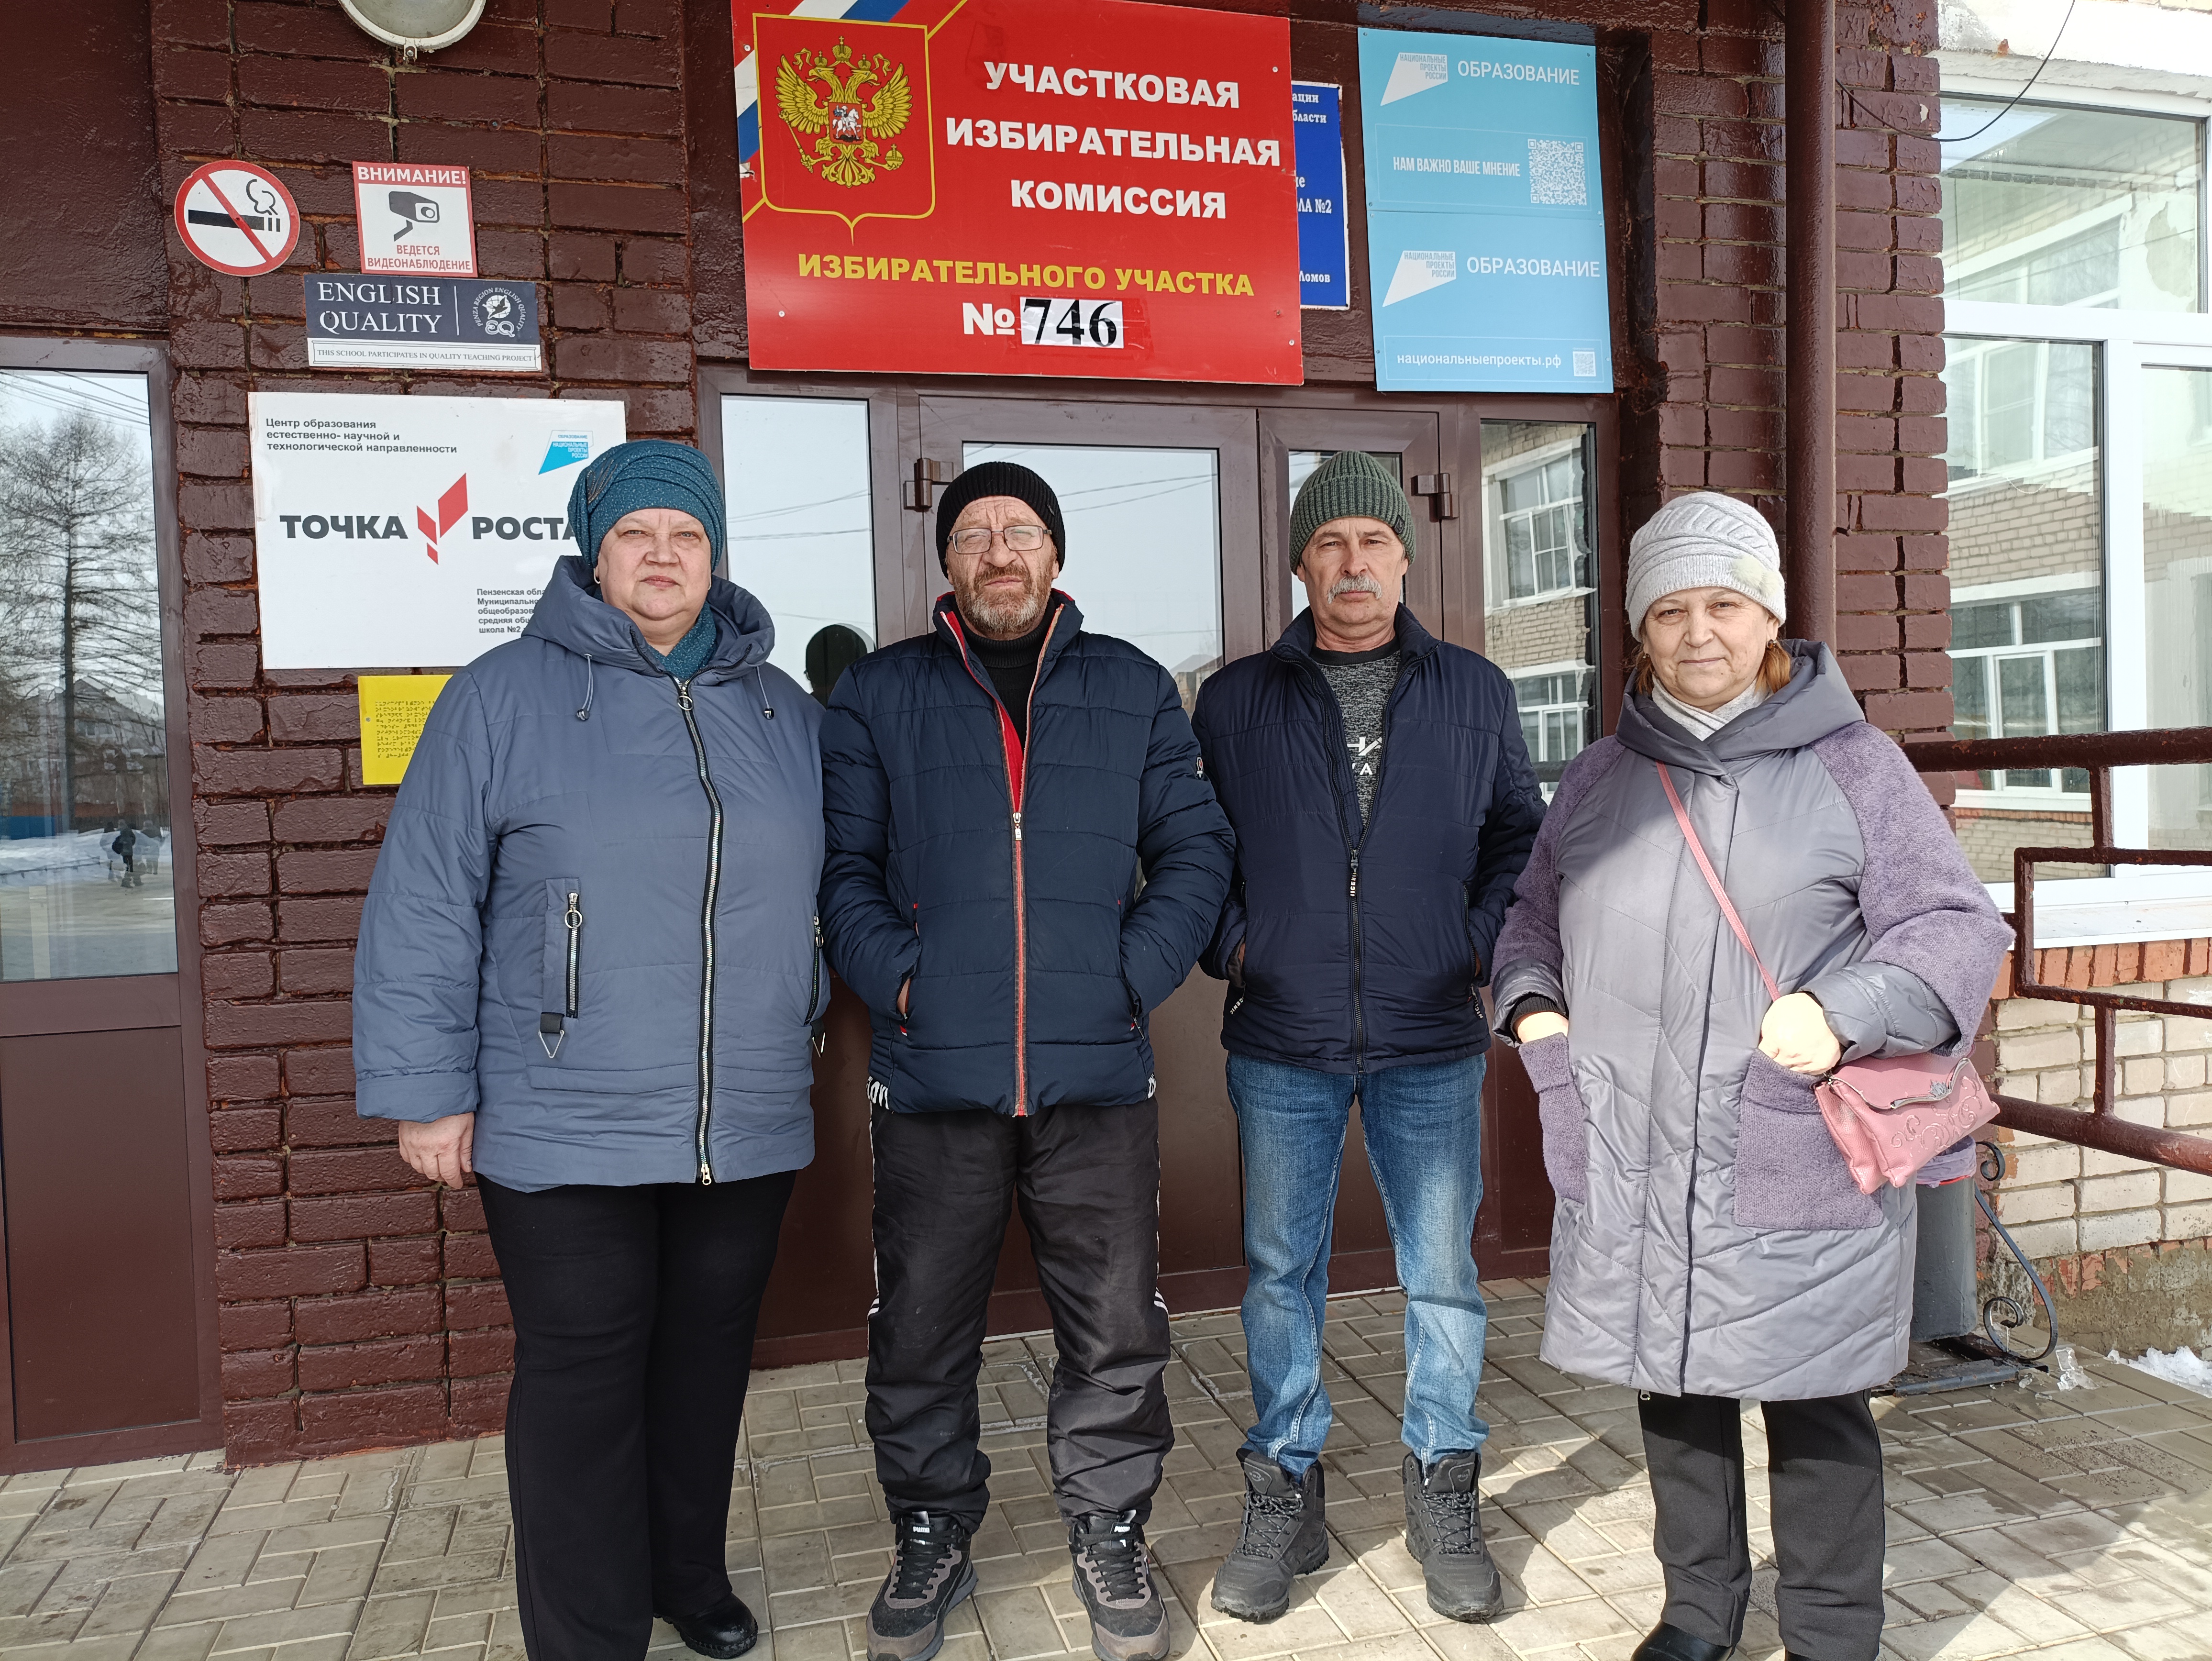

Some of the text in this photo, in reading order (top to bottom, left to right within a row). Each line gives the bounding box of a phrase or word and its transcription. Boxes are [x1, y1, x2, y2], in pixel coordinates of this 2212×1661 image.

[1400, 54, 1446, 64] НАЦИОНАЛЬНЫЕ
[1420, 63, 1446, 72] ПРОЕКТЫ
[1458, 60, 1580, 85] ОБРАЗОВАНИЕ
[1425, 71, 1447, 80] РОССИИ
[984, 60, 1239, 109] УЧАСТКОВАЯ
[1292, 93, 1319, 103] ации
[1292, 109, 1327, 123] бласти
[946, 117, 1280, 166] ИЗБИРАТЕЛЬНАЯ
[1393, 156, 1521, 177] НАМ ВАЖНО ВАШЕ МНЕНИЕ
[358, 166, 466, 184] ВНИМАНИЕ!
[1010, 179, 1227, 219] КОМИССИЯ
[1315, 199, 1332, 214] №2
[397, 245, 440, 256] ВЕДЕТСЯ
[1404, 252, 1454, 261] НАЦИОНАЛЬНЫЕ
[367, 258, 471, 271] ВИДЕОНАБЛЮДЕНИЕ
[1426, 261, 1454, 269] ПРОЕКТЫ
[1467, 256, 1600, 277] ОБРАЗОВАНИЕ
[798, 254, 1255, 297] ИЗБИРАТЕЛЬНОГО УЧАСТКА
[1432, 269, 1455, 278] РОССИИ
[317, 282, 441, 305] ENGLISH
[472, 287, 526, 331] PENZA REGION ENGLISH QUALITY
[320, 311, 442, 334] QUALITY
[1022, 298, 1118, 348] 746
[1397, 354, 1561, 368] национальныепроекты.рф
[266, 418, 376, 429] Центр образования
[266, 431, 341, 439] естественно-
[343, 432, 389, 442] научной
[267, 442, 457, 454] технологической направленности
[279, 515, 409, 539] ТОЧКА
